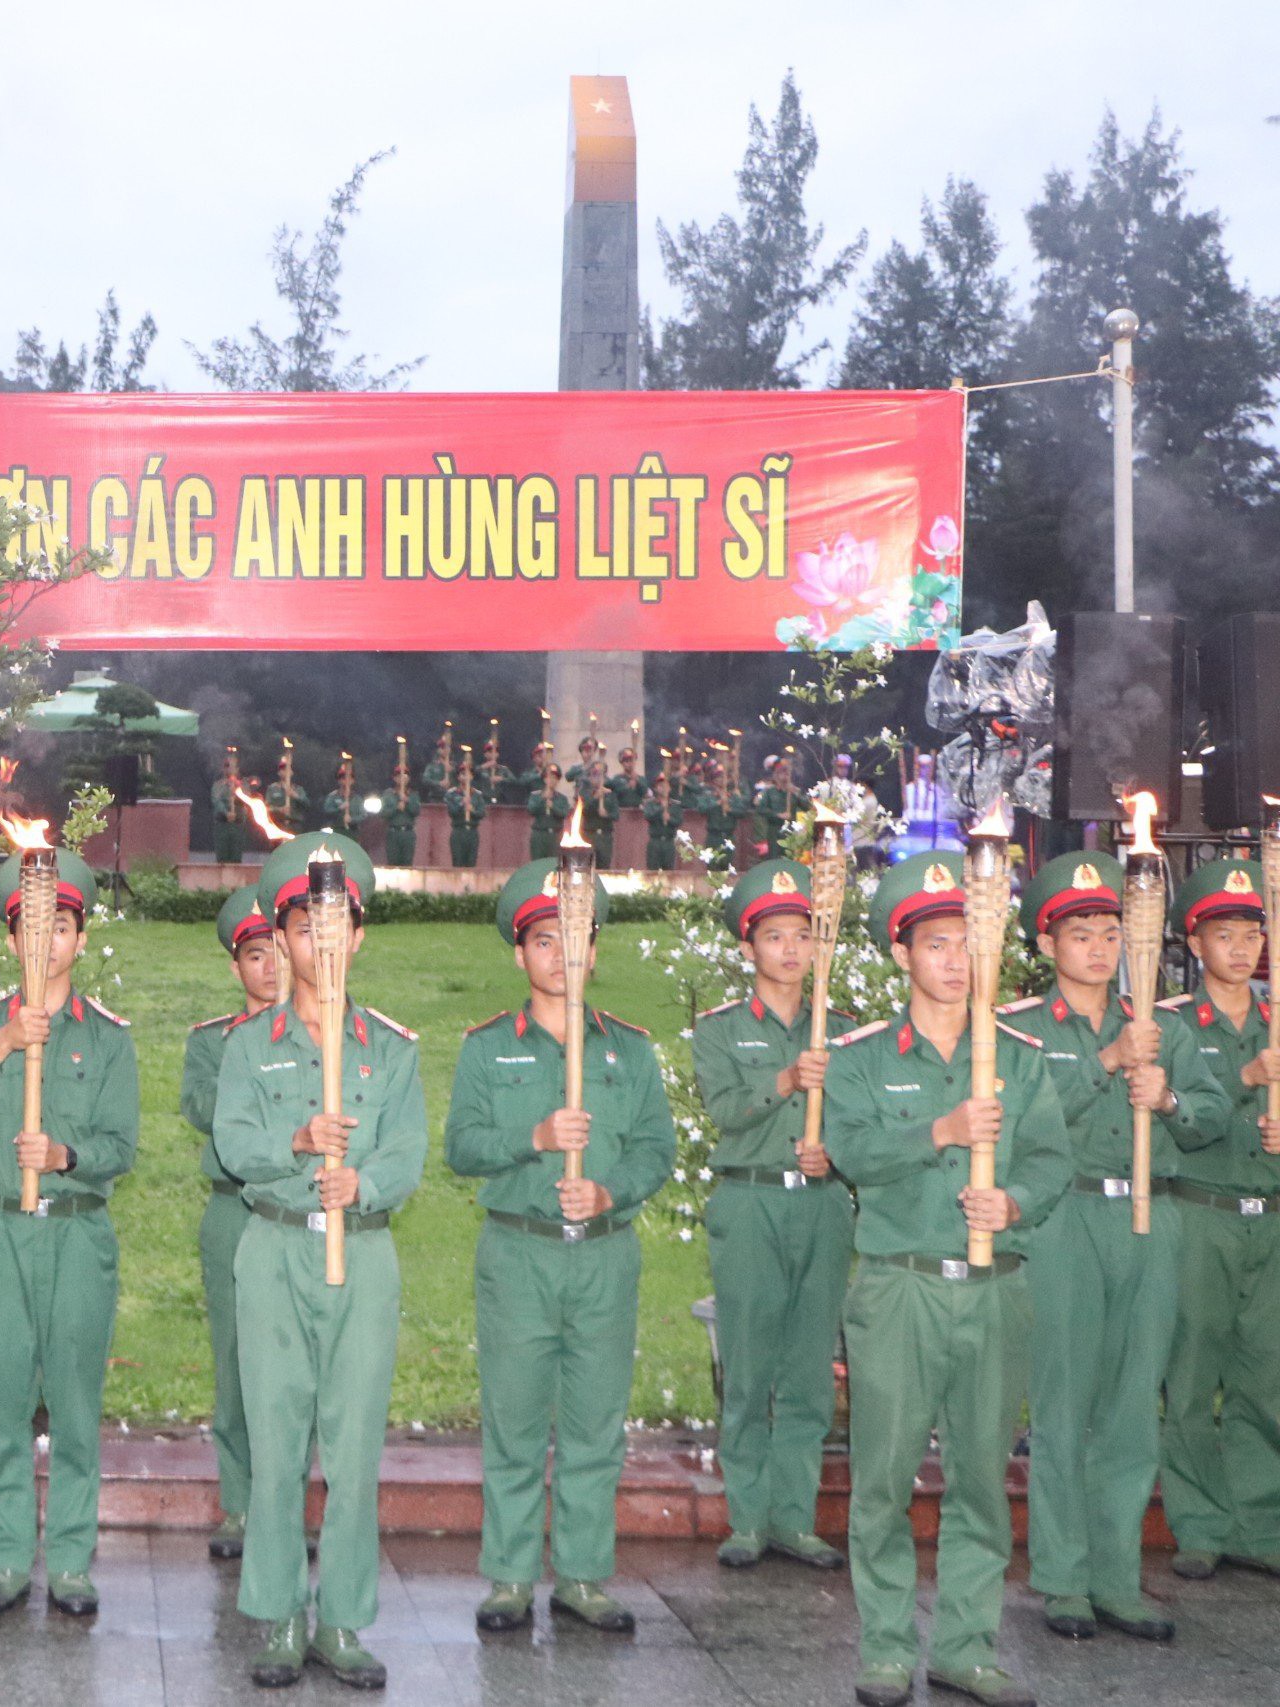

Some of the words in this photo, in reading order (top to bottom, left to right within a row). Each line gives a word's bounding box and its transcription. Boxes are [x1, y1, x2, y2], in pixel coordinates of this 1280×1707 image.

[87, 453, 216, 581] CÁC
[232, 474, 366, 581] ANH
[381, 451, 560, 582] HÙNG
[575, 451, 708, 604] LIỆT
[721, 452, 794, 582] SĨ
